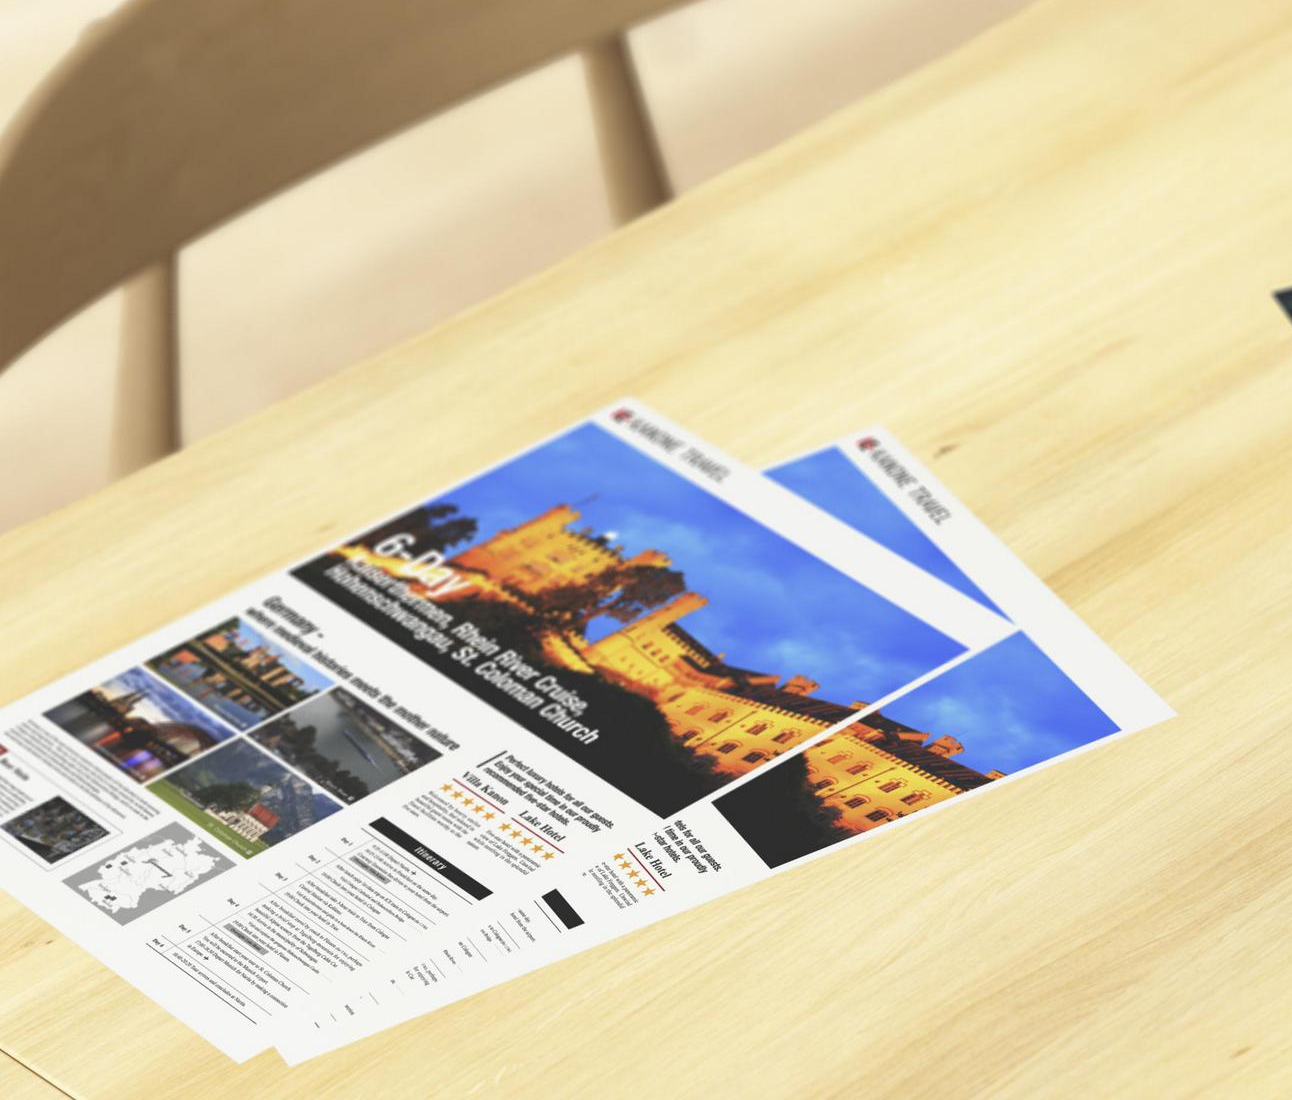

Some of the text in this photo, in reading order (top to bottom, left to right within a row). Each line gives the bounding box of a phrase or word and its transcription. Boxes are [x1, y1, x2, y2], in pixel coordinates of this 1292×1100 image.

[374, 531, 470, 599] 6-Day
[450, 621, 501, 657] Rhein
[489, 649, 541, 681] River
[533, 675, 588, 717] Cruise,
[450, 645, 479, 667] St.
[474, 660, 545, 710] Coloman
[539, 702, 600, 745] Church
[377, 694, 398, 710] the
[393, 705, 431, 731] mother
[425, 727, 461, 752] nature
[462, 770, 509, 806] Villa Kanon
[482, 767, 570, 827] recommended five-star hotels.
[493, 760, 602, 833] Enjoy your special time in our proudly
[504, 754, 615, 830] Perfect luxury hotels for all our guests.
[517, 809, 567, 843] Lake Hotel
[682, 829, 694, 839] for
[688, 837, 702, 846] all
[413, 846, 447, 871] Itinerary
[634, 841, 673, 879] Lake Hotel
[662, 844, 681, 864] hotels.
[664, 827, 709, 874] time in our proudly
[694, 844, 708, 854] our
[700, 853, 722, 873] guests.
